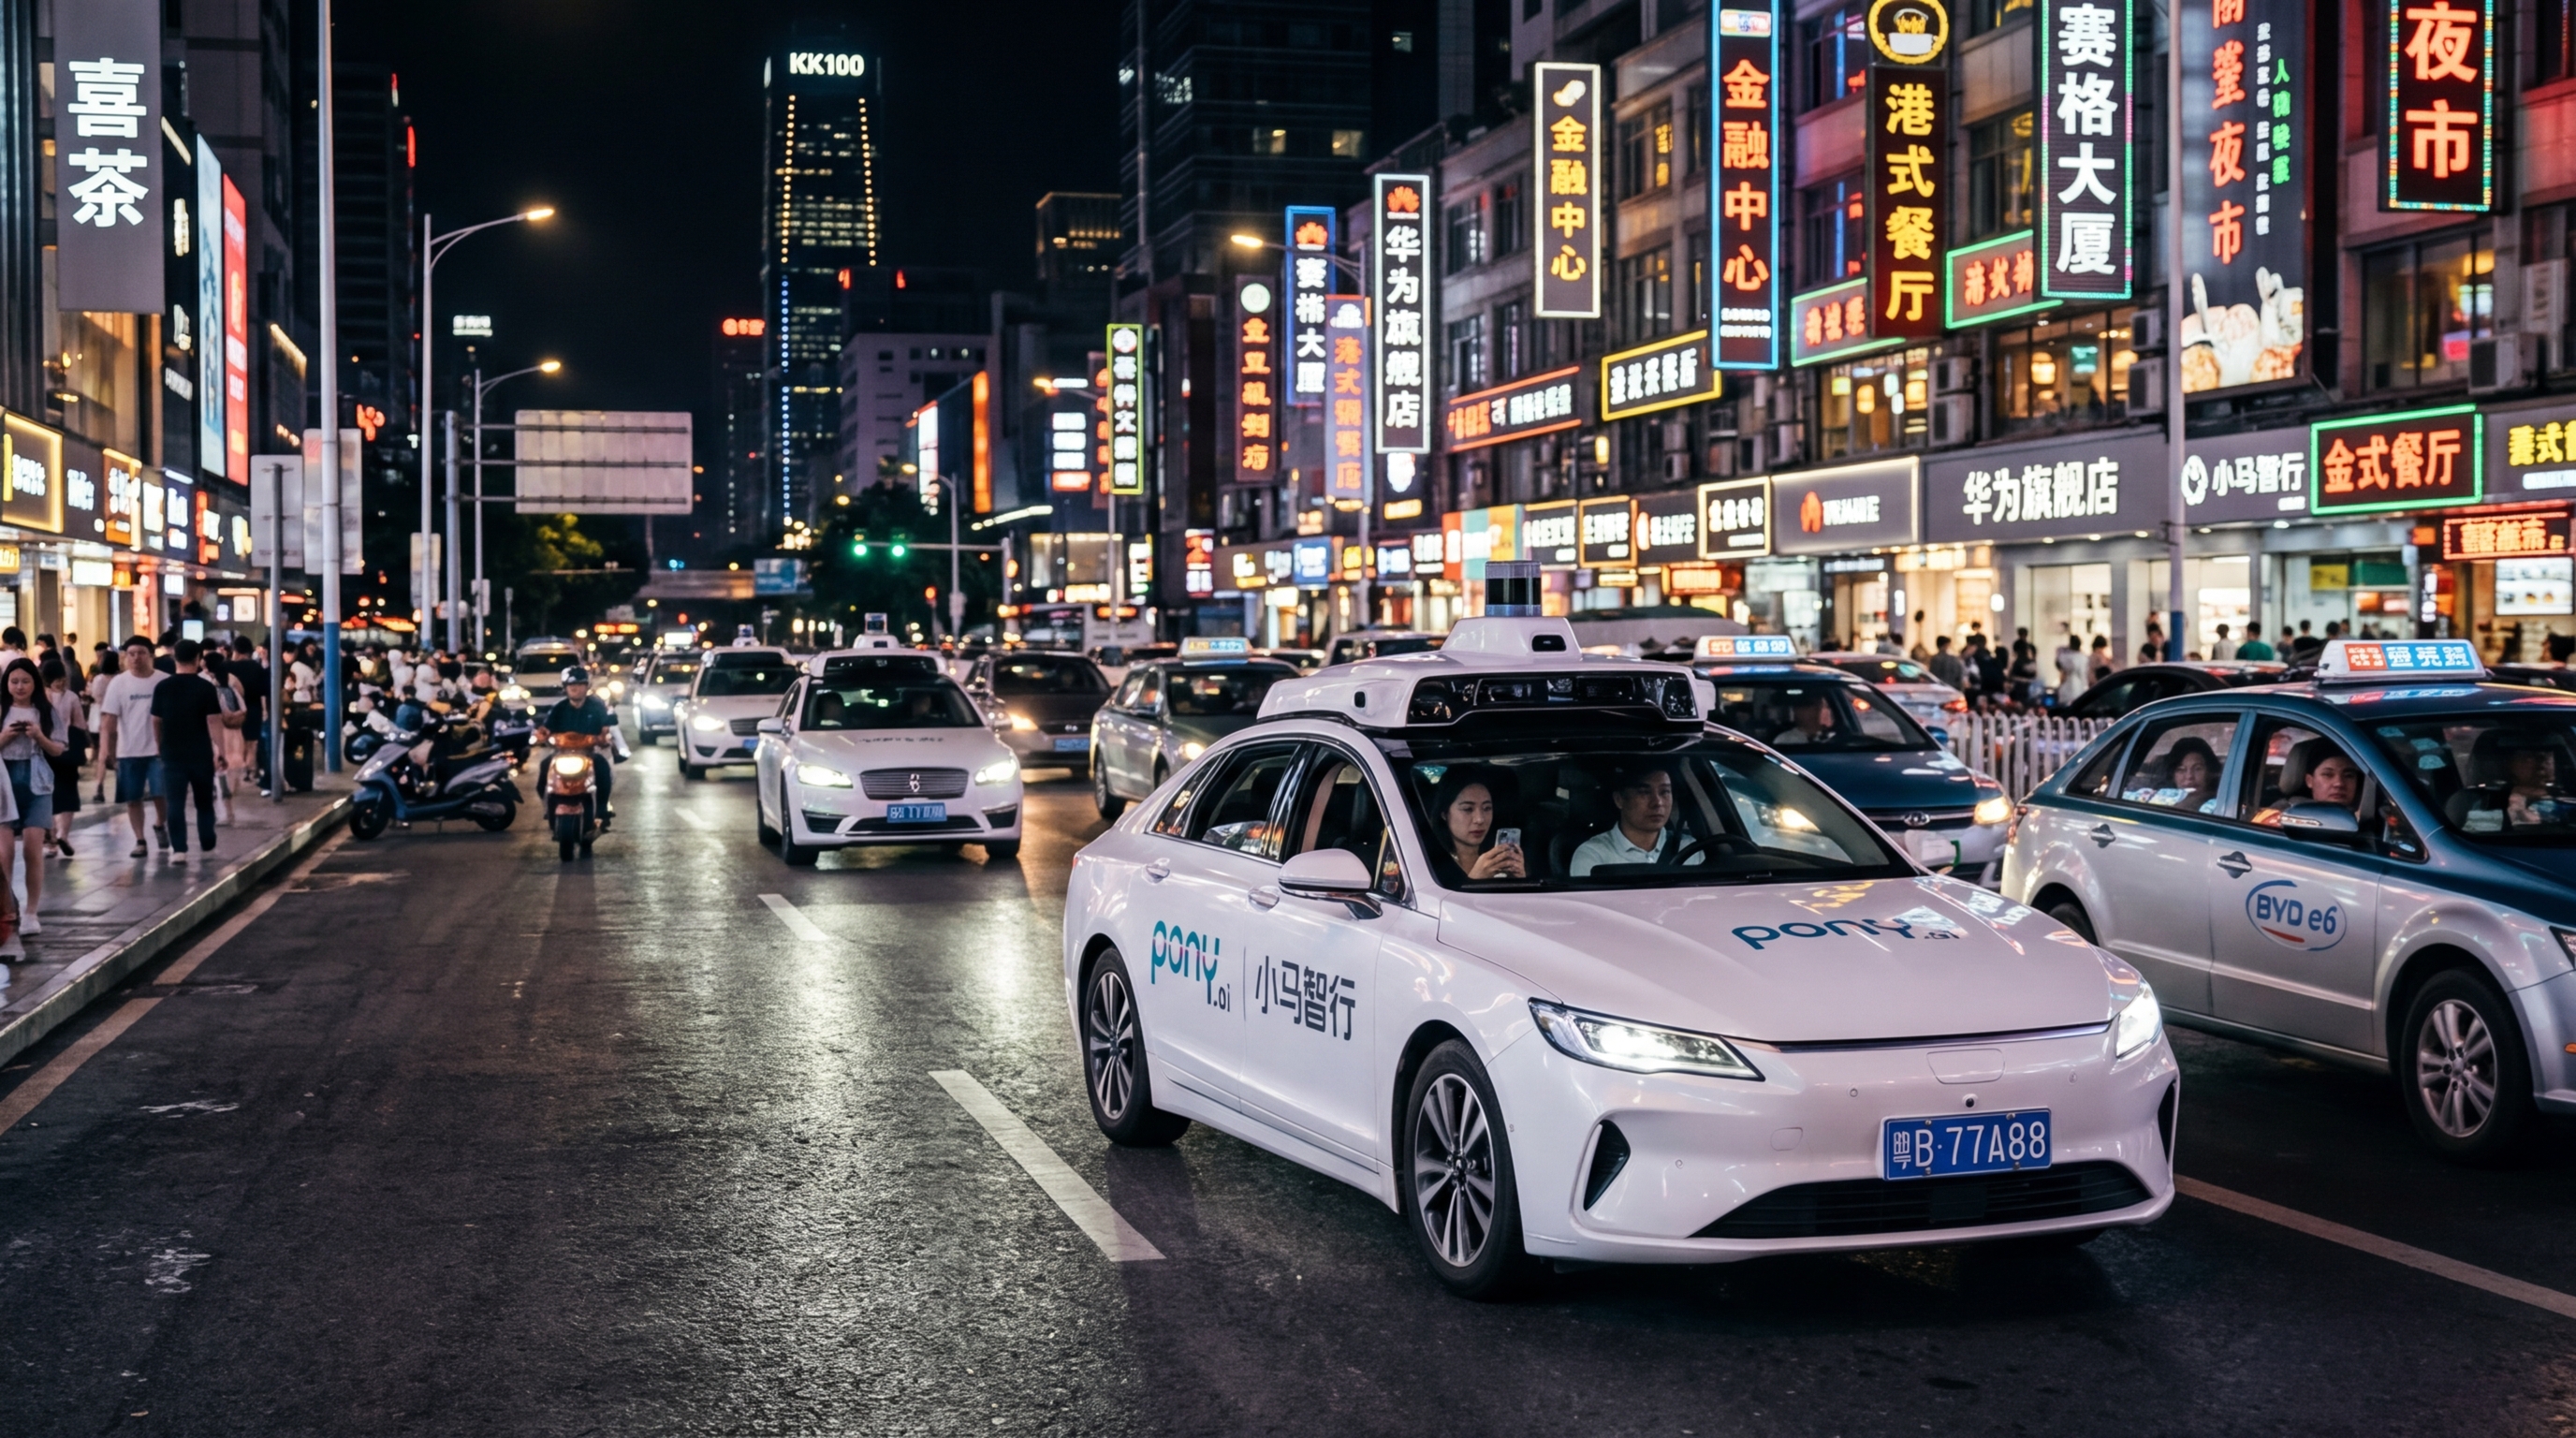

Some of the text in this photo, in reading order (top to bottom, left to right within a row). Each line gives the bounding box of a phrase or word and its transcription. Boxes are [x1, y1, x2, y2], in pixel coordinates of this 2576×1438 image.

[67, 57, 149, 227] 喜茶
[790, 52, 865, 77] KK100
[2056, 3, 2118, 276] 赛格大厦
[2404, 1, 2479, 179] 夜市
[1550, 115, 1588, 281] 金融中心
[1722, 59, 1770, 291] 金融中心
[1885, 82, 1936, 321] 港式餐厅
[1963, 456, 2119, 526] 华为旗舰店
[2323, 429, 2462, 493] 金式餐厅
[2257, 893, 2338, 935] BYD e6
[1255, 955, 1356, 1042] 小马智行
